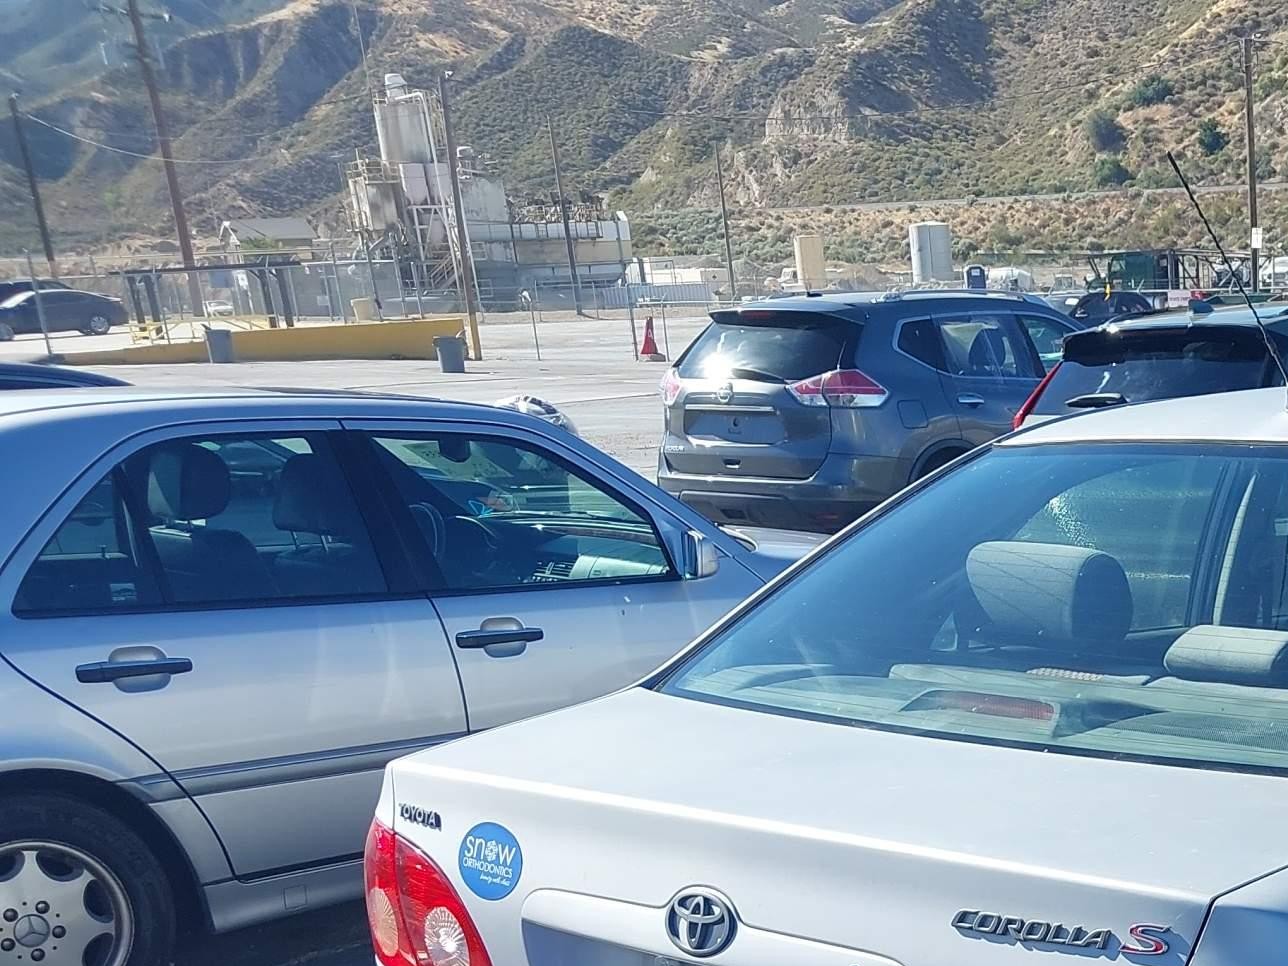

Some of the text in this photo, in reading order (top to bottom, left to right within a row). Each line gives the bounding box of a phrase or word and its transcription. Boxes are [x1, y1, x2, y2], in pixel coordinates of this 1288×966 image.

[398, 802, 439, 830] TOYOTA
[462, 856, 513, 879] ORTHODONTICS
[950, 908, 1172, 956] COROLLA S
